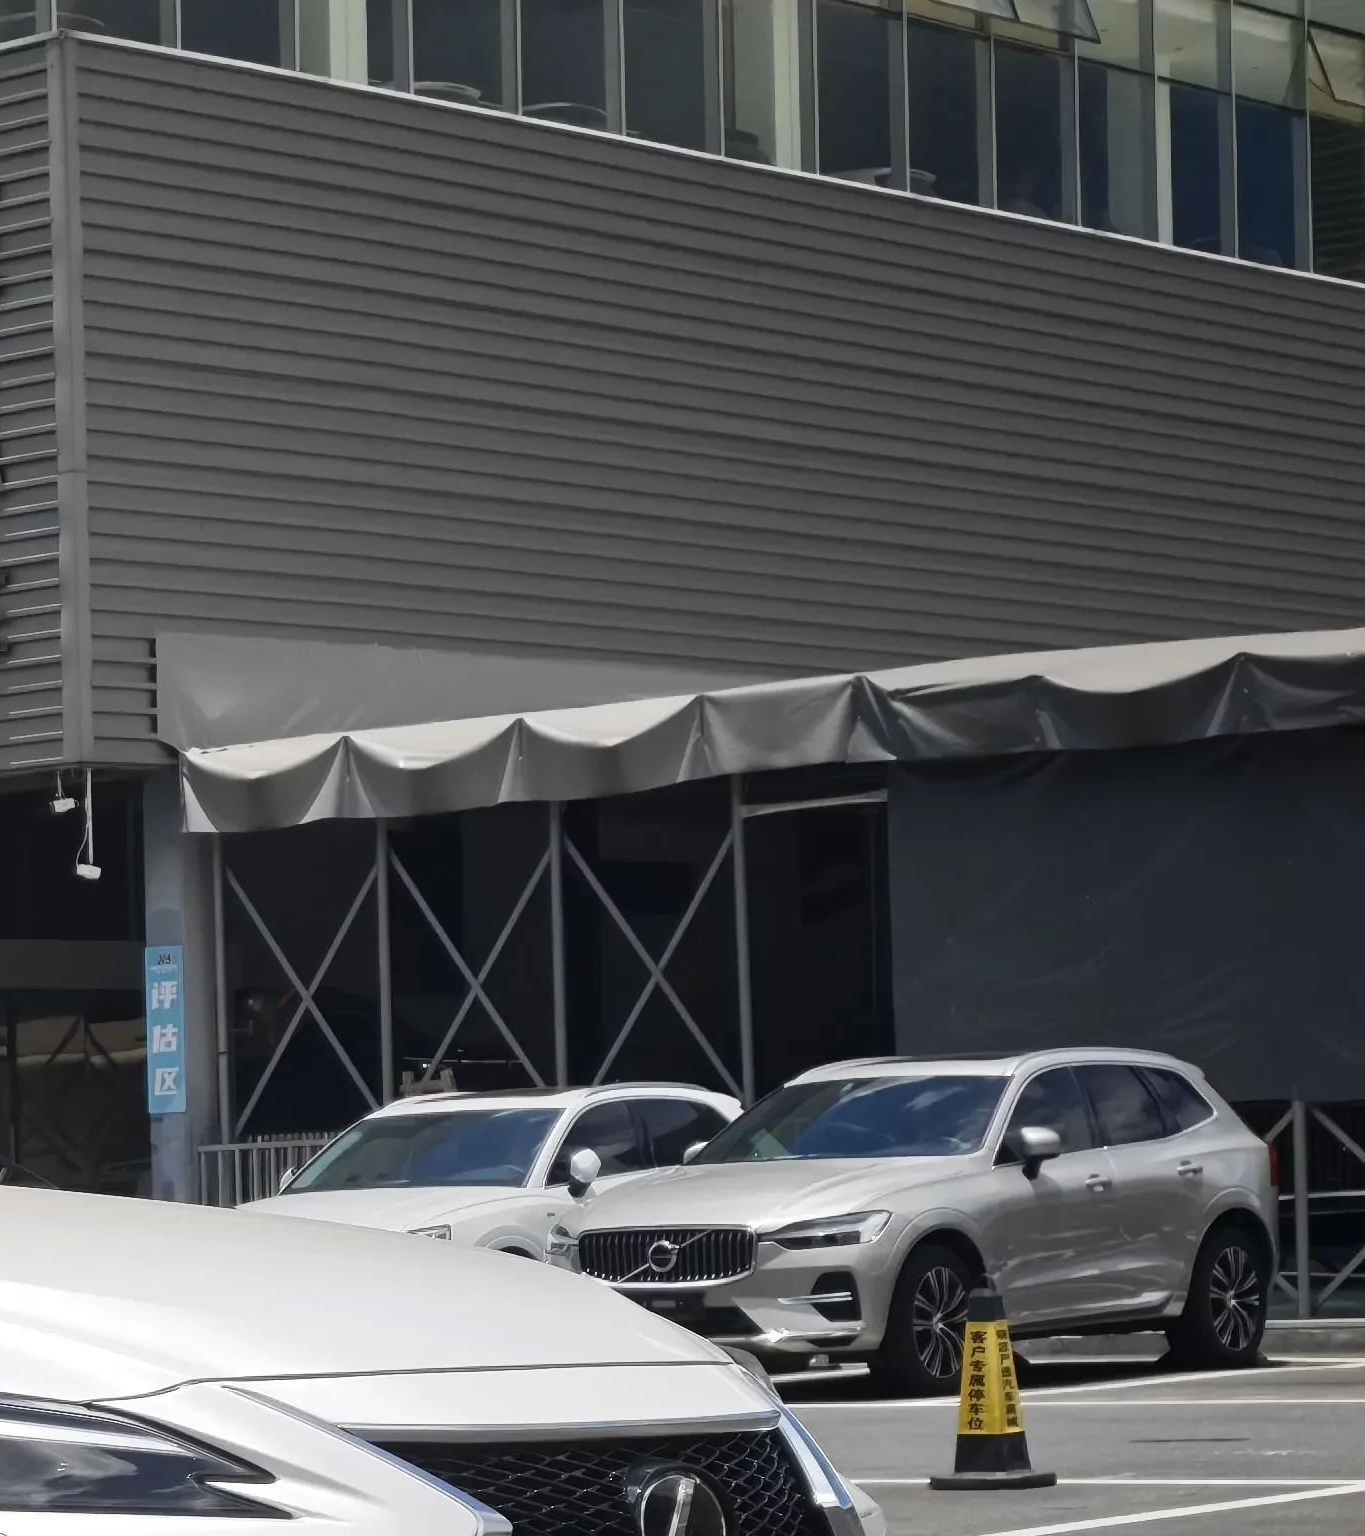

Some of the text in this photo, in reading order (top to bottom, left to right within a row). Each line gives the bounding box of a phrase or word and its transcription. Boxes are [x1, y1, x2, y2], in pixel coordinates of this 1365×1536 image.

[151, 981, 179, 1096] 评估区
[967, 1330, 987, 1430] 客户专属停车位
